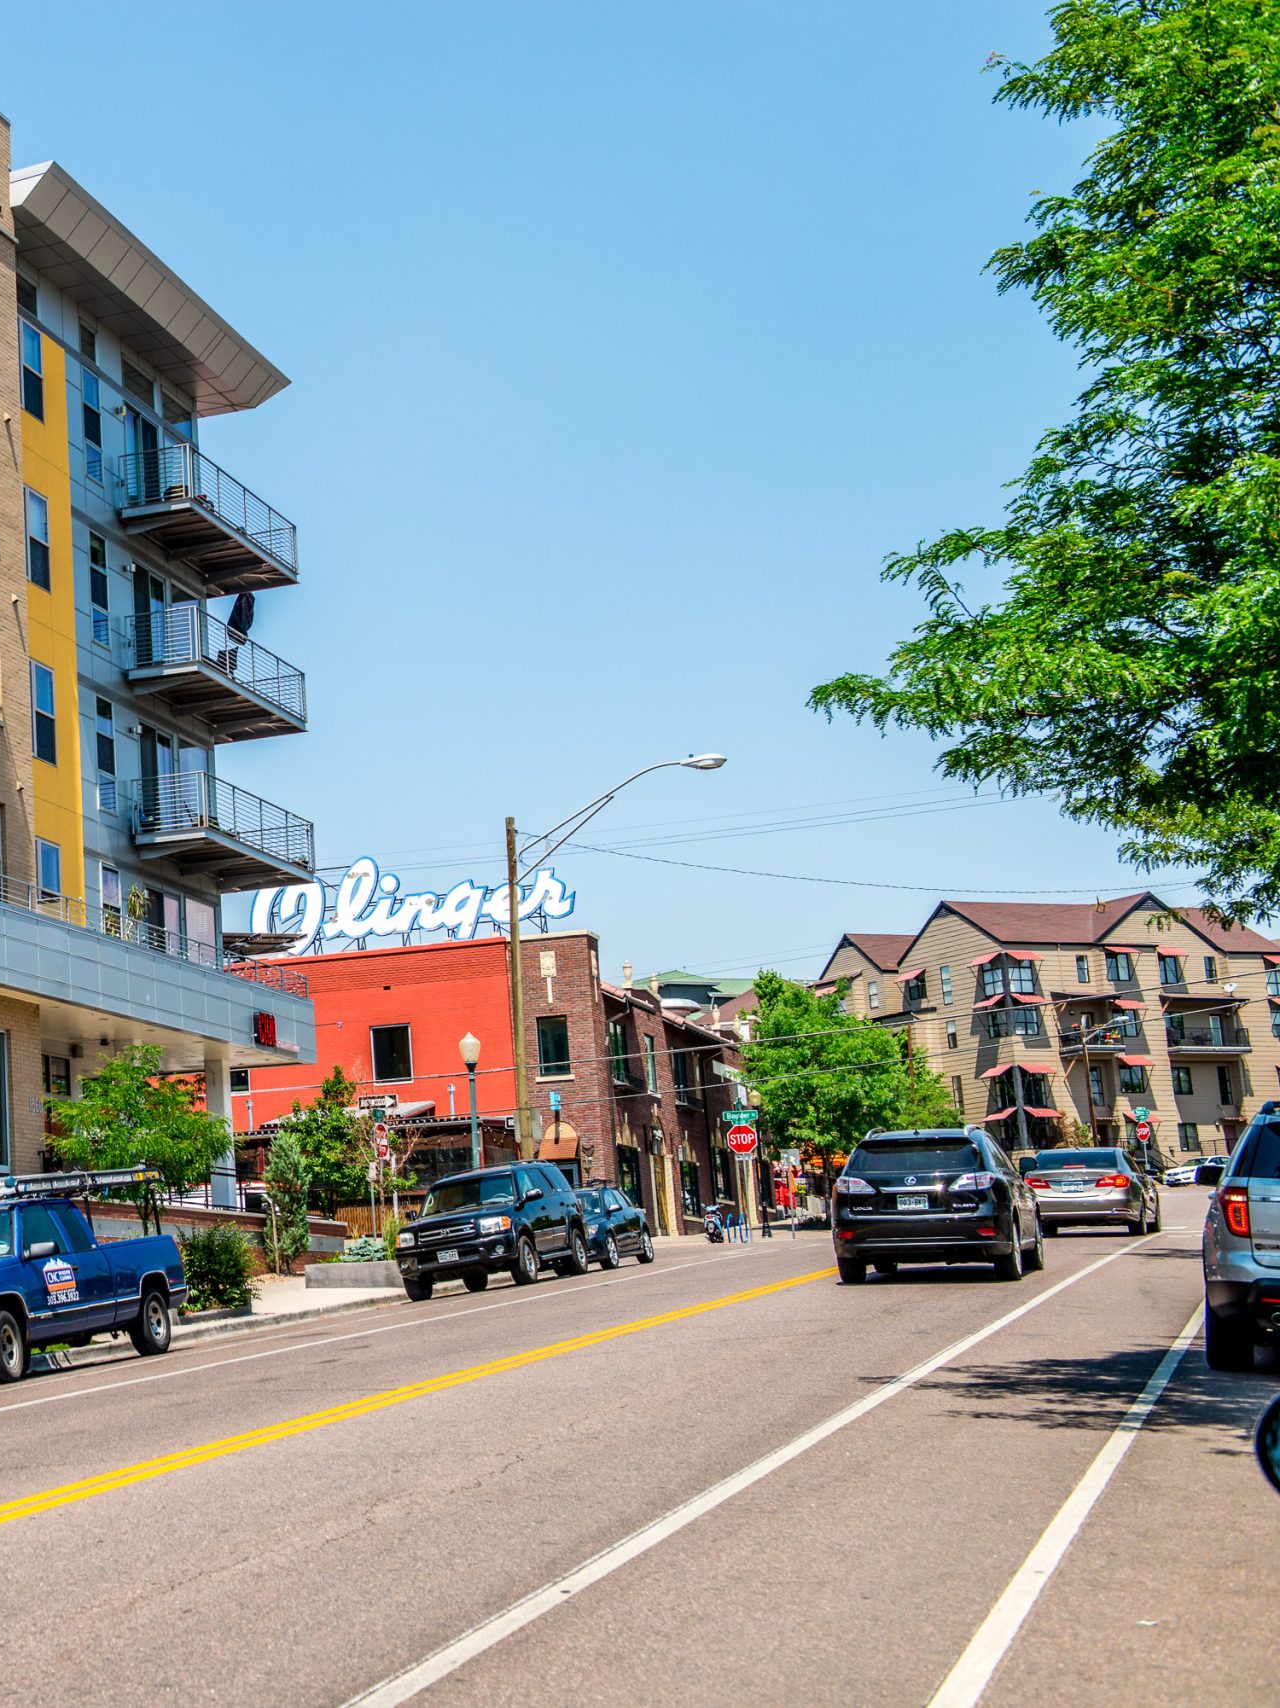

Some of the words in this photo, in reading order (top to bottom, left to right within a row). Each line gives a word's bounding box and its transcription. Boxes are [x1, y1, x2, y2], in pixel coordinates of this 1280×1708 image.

[250, 856, 576, 957] Olinger
[726, 1112, 750, 1120] Boulder
[1137, 1127, 1150, 1136] STOP
[730, 1133, 755, 1145] STOP
[47, 1271, 61, 1284] CNC
